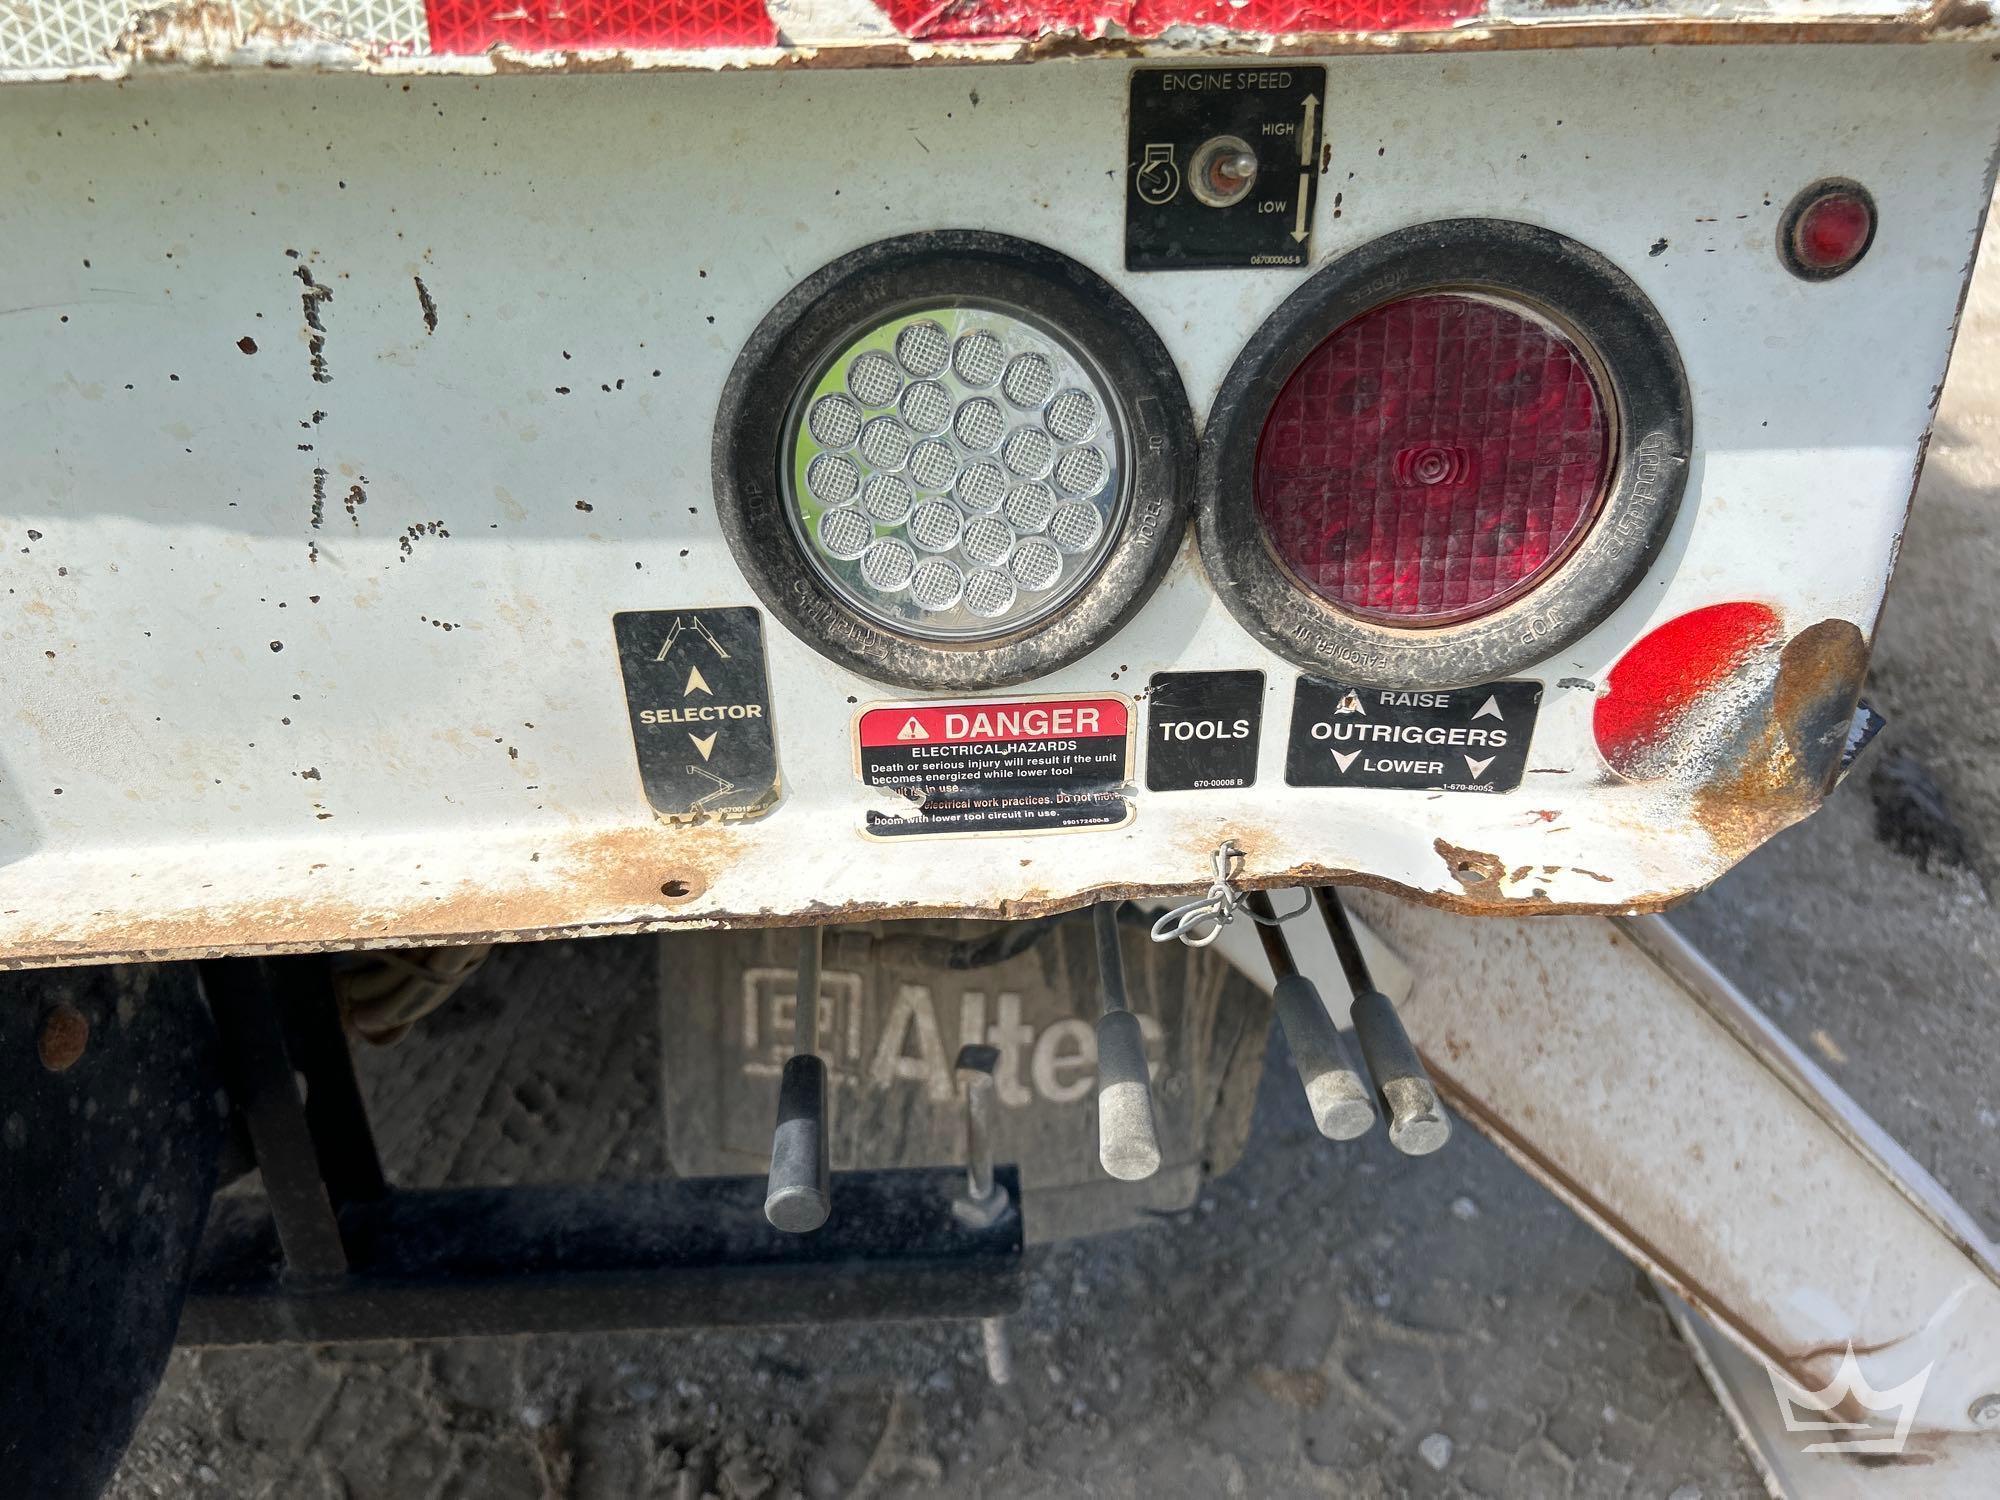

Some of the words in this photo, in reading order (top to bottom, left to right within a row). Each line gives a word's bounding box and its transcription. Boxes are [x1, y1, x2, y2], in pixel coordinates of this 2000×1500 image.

[1163, 74, 1231, 90] ENGINE
[1237, 72, 1292, 89] SPEED
[1262, 123, 1294, 136] HIGH
[1258, 201, 1287, 213] LOW
[1521, 605, 1563, 644] TOP
[1379, 691, 1449, 708] RAISE
[639, 704, 762, 724] SELECTOR
[945, 708, 1100, 739] DANGER
[1159, 720, 1250, 741] TOOLS
[1311, 722, 1507, 747] OUTRIGGERS
[912, 744, 1001, 758] ELECTRICAL
[1007, 740, 1077, 754] HAZARDS
[871, 763, 904, 773] Death
[907, 763, 919, 771] or
[922, 761, 964, 771] serious
[968, 759, 1000, 770] injury
[1003, 757, 1024, 766] will
[1027, 756, 1060, 766] result
[1063, 755, 1071, 764] if
[1073, 754, 1092, 763] the
[1095, 753, 1117, 763] unit
[1363, 759, 1444, 775] LOWER
[872, 774, 922, 785] becomes
[925, 771, 981, 782] energized
[984, 769, 1013, 779] while
[1017, 768, 1047, 778] lower
[1051, 767, 1073, 776] tool
[1193, 779, 1235, 788] 670-00008
[1237, 778, 1243, 786] B
[925, 784, 936, 793] in
[1443, 783, 1494, 792] 1-670-80052
[924, 799, 970, 810] electrical
[973, 799, 999, 808] work
[1002, 795, 1053, 807] practices.
[1056, 793, 1070, 804] Do
[1073, 792, 1091, 802] not
[874, 815, 904, 825] boom
[907, 814, 929, 824] with
[932, 813, 960, 823] lower
[964, 811, 985, 821] tool
[987, 809, 1021, 819] circuit
[1024, 809, 1034, 818] in
[1037, 809, 1060, 818] use.
